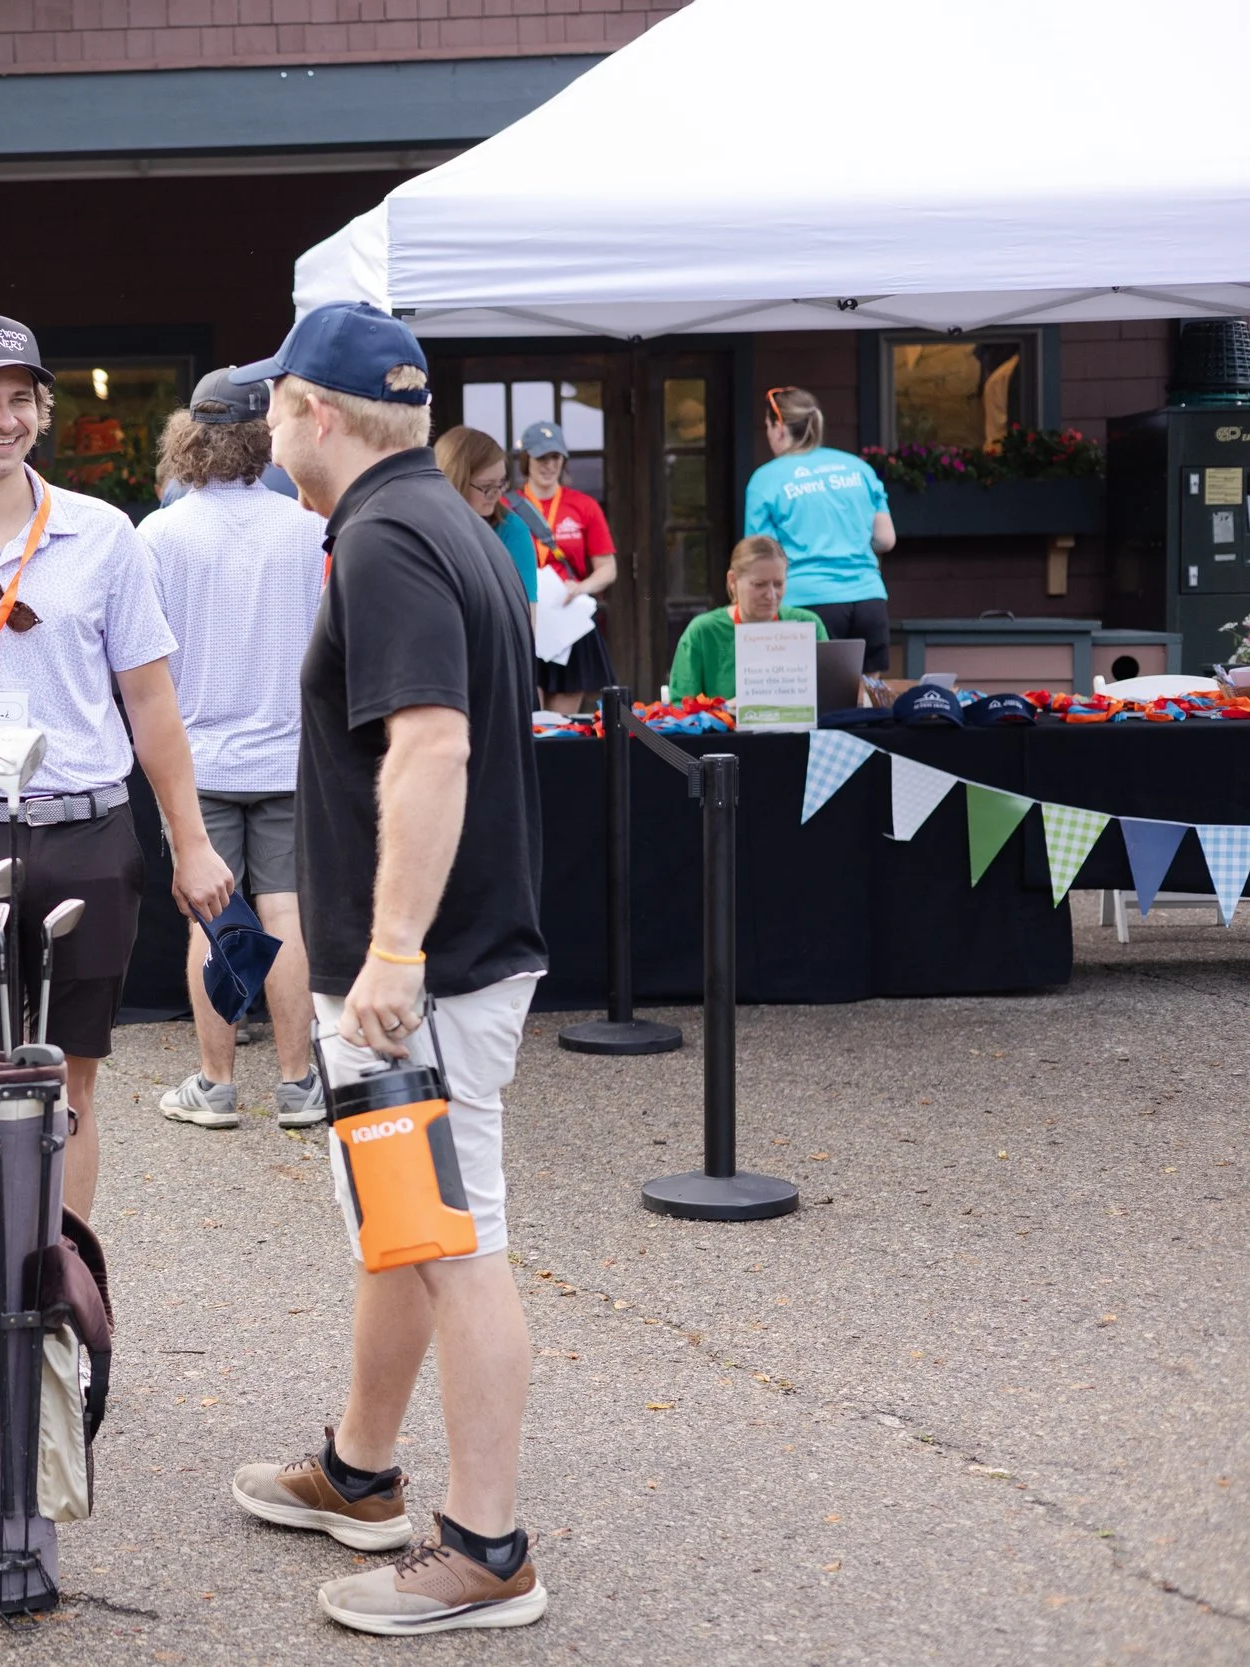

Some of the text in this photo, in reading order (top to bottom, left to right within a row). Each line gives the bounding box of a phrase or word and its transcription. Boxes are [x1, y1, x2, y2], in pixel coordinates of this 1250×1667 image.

[783, 471, 862, 500] Event Staff
[351, 1117, 414, 1144] IGLOO
